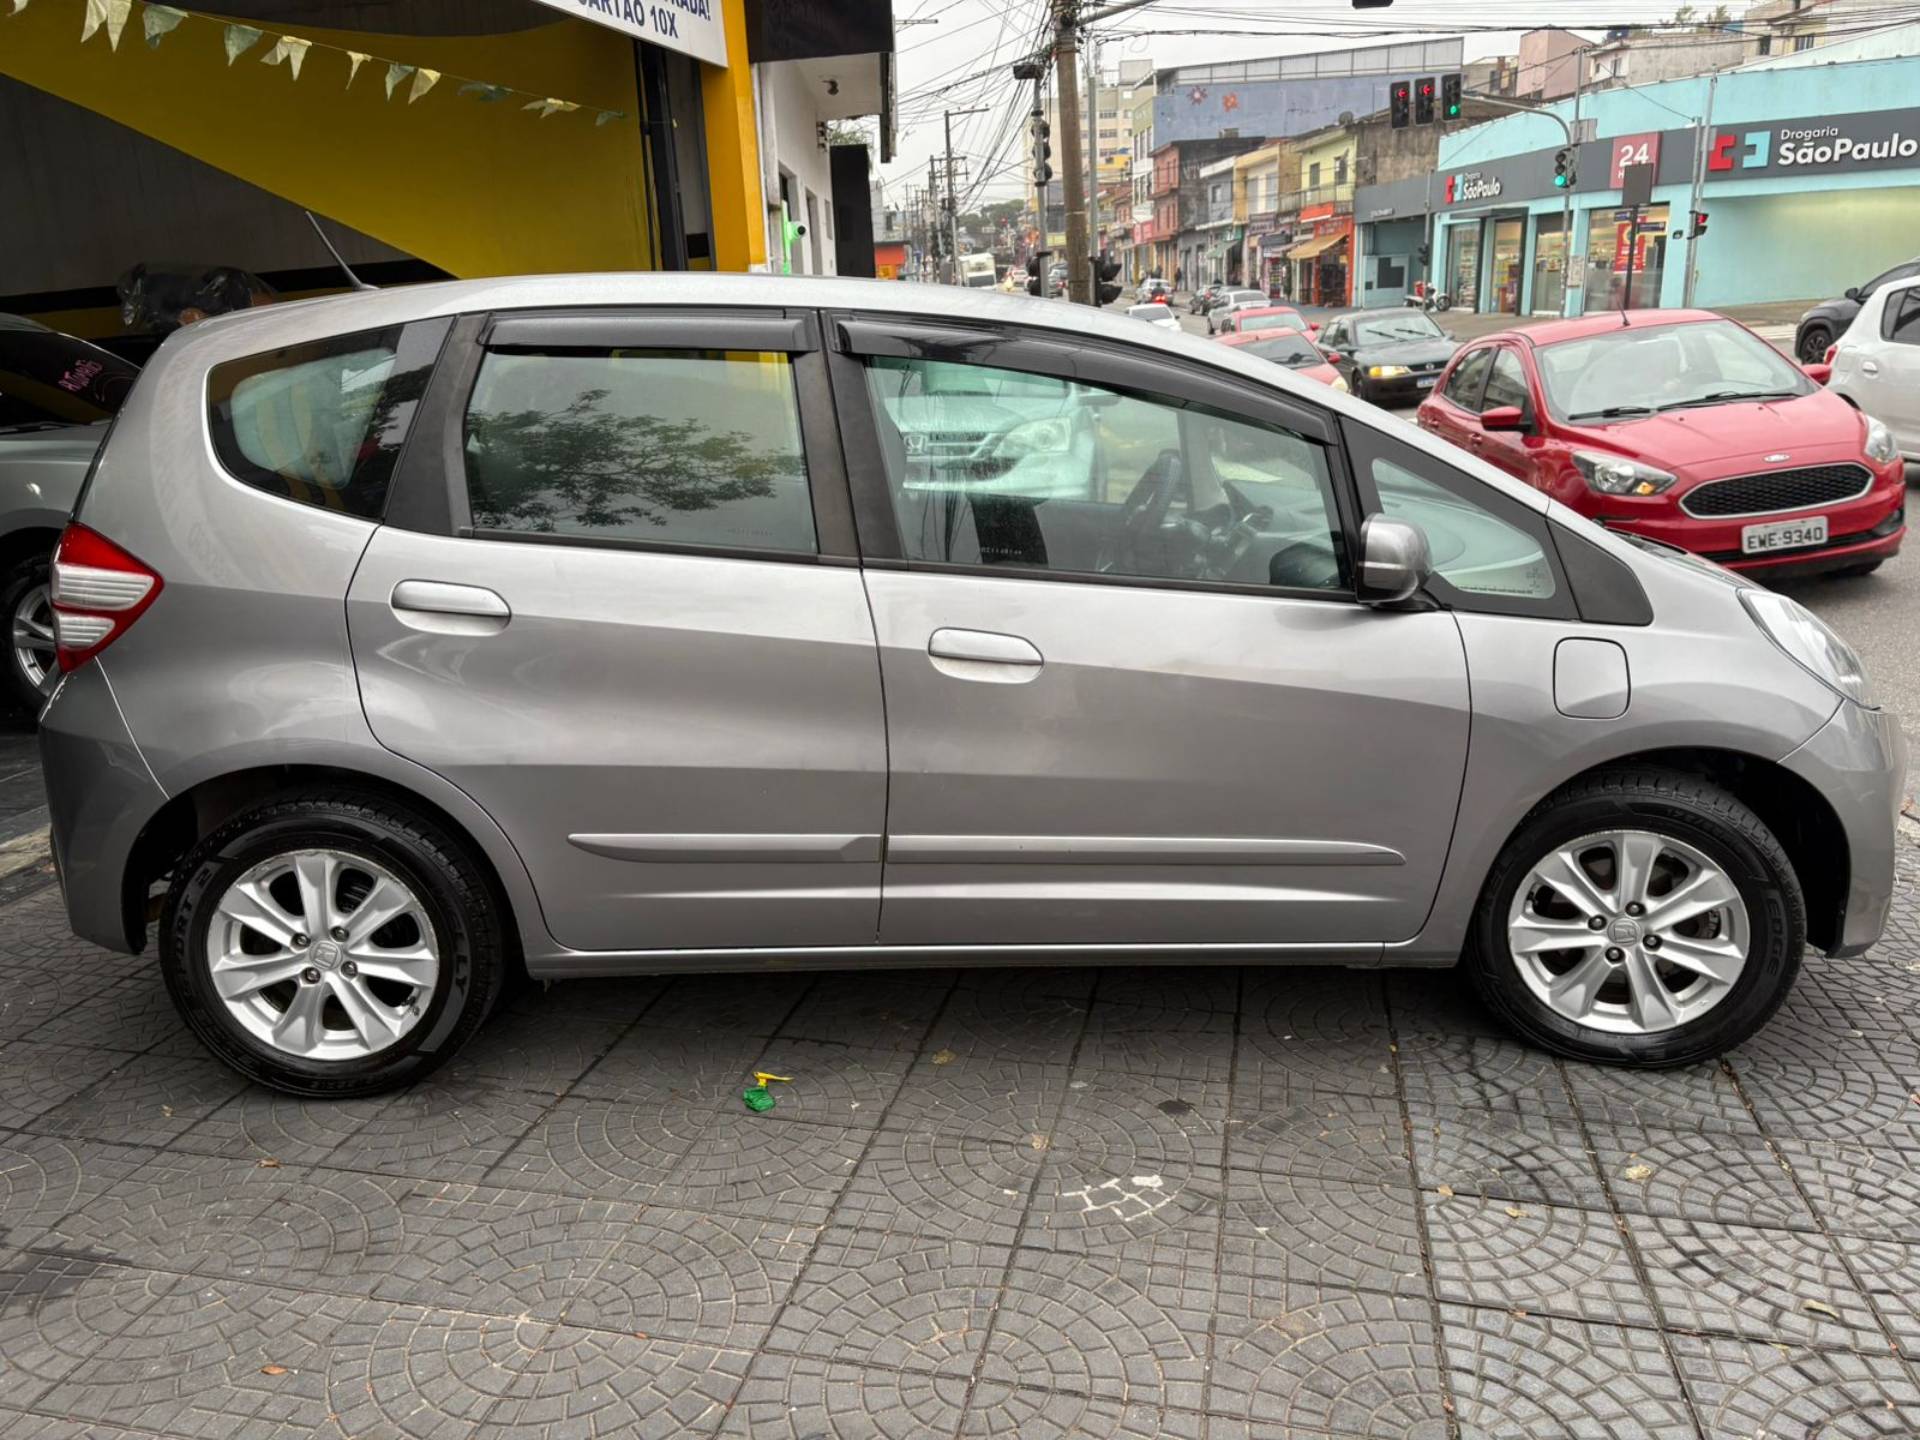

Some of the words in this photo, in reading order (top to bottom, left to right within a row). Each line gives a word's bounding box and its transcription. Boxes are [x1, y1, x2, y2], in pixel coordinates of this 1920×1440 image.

[650, 5, 678, 39] 10X
[1778, 133, 1918, 165] SãoPaulo
[1780, 126, 1839, 141] Drogaria
[1619, 143, 1649, 168] 24
[1766, 897, 1785, 977] EDGE
